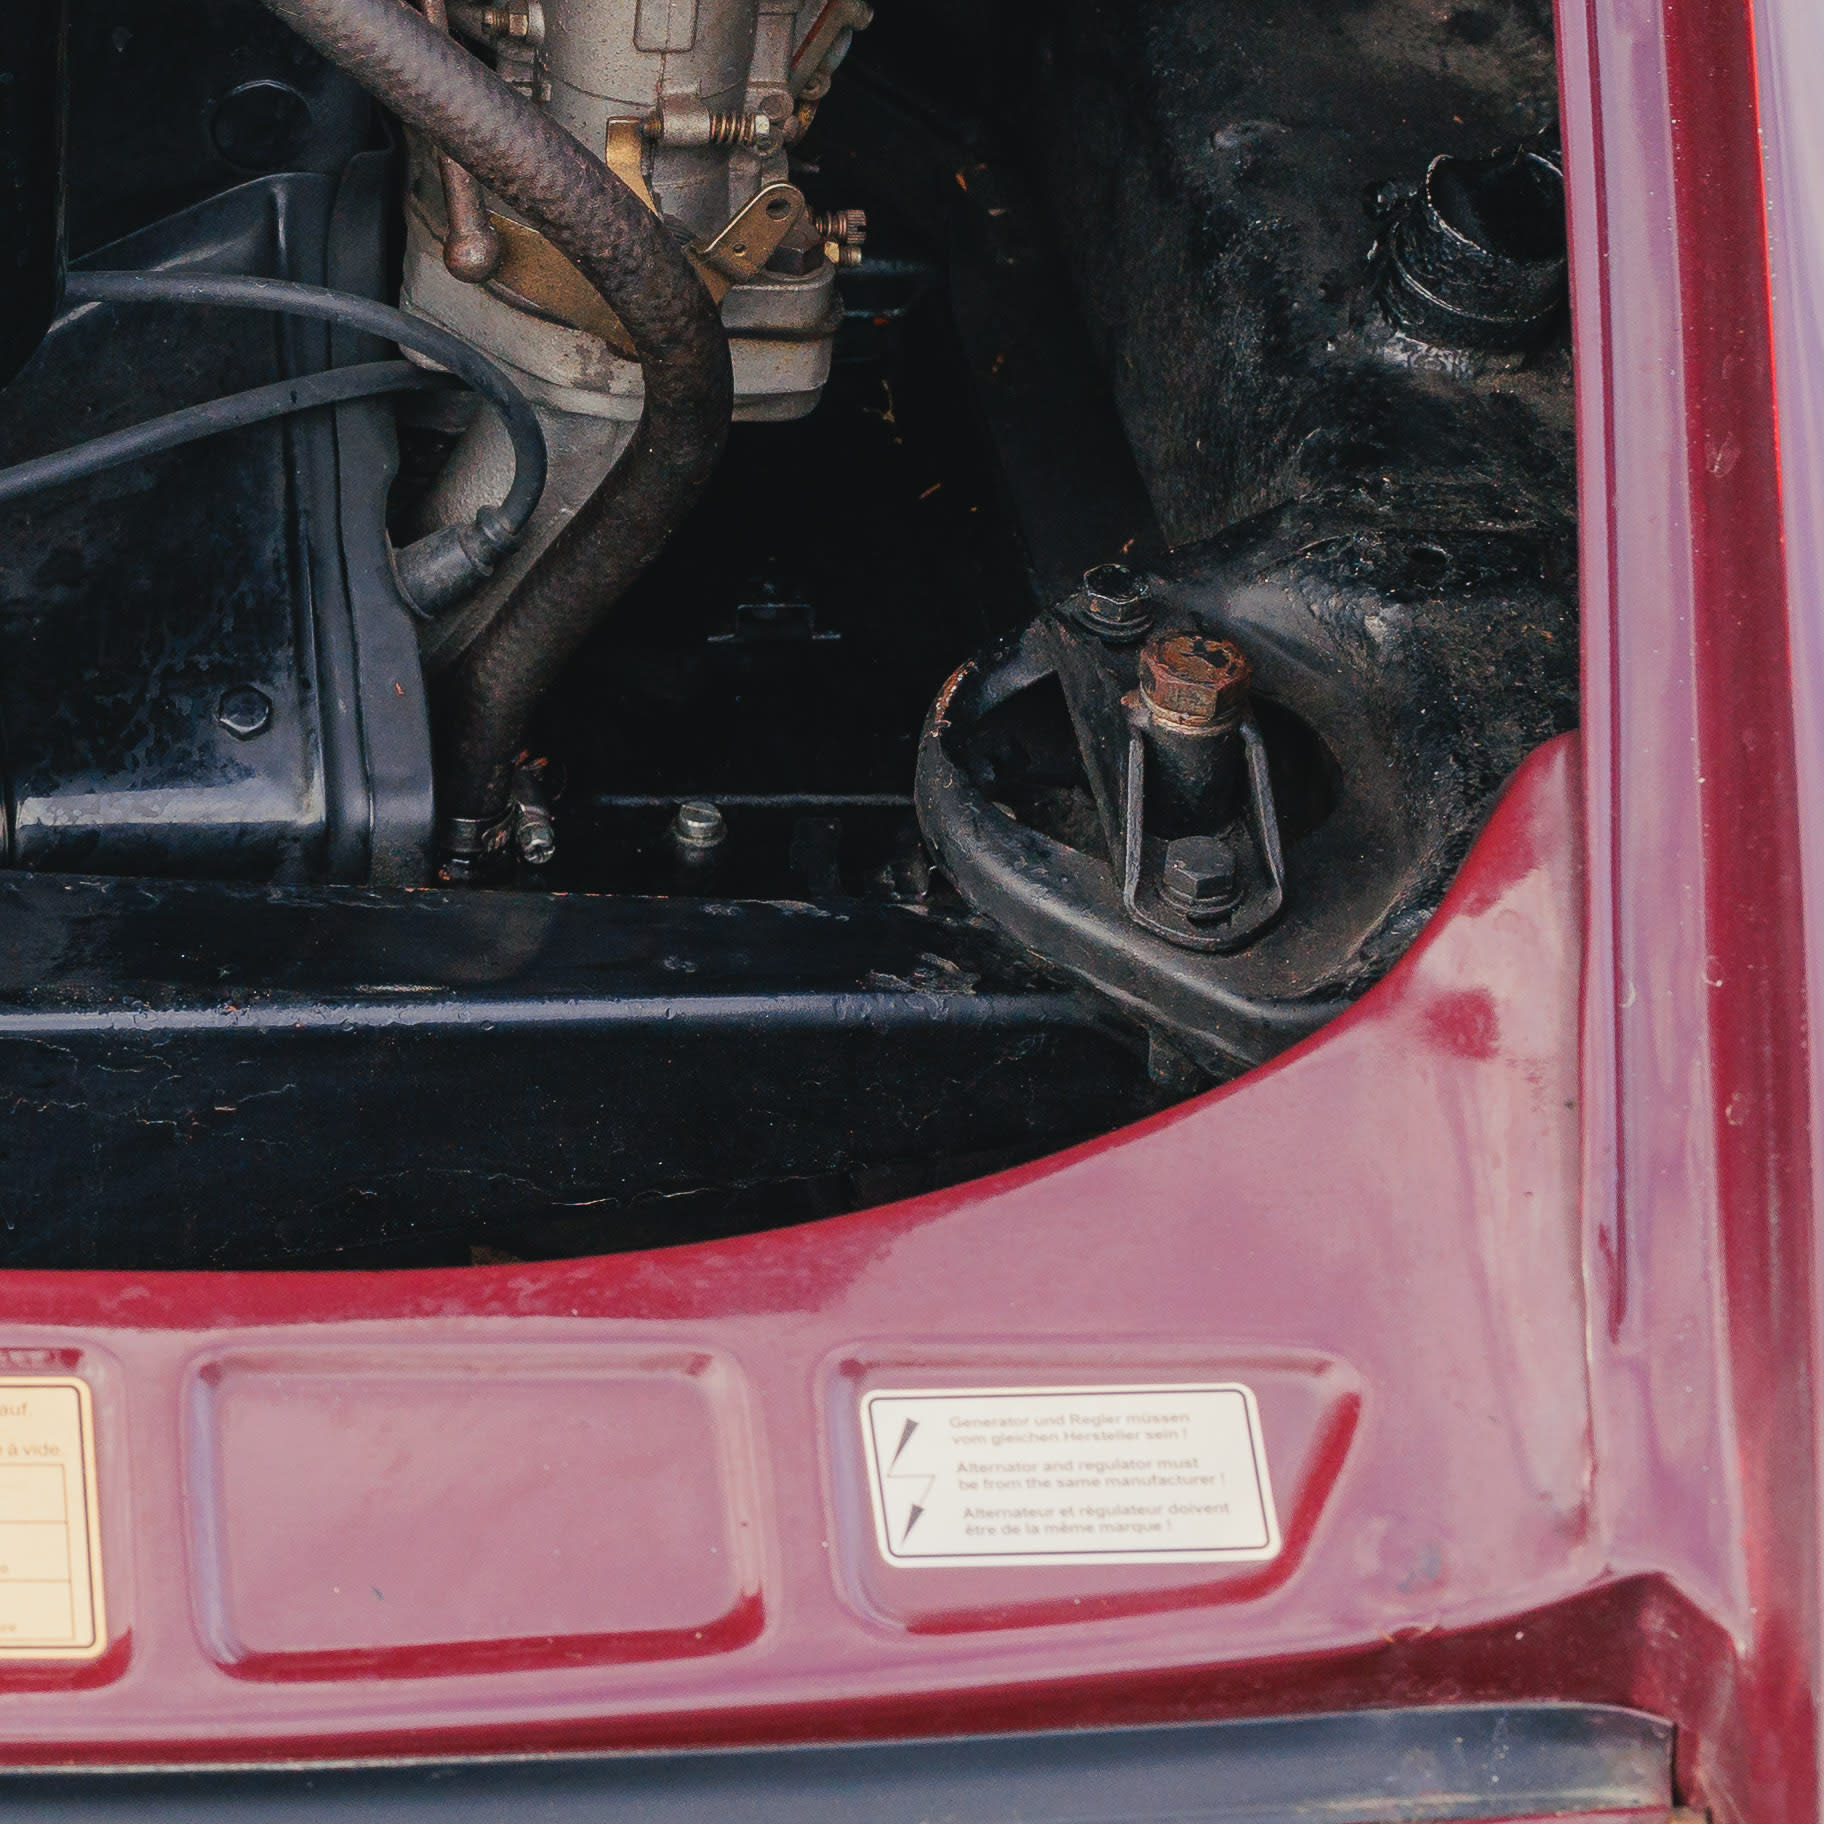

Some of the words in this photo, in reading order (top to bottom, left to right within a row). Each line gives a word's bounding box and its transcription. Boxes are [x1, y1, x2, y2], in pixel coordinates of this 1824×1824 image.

[949, 1415, 1030, 1428] Generator
[1034, 1414, 1065, 1426] und
[956, 1460, 1038, 1474] Alternator
[1042, 1459, 1073, 1473] and
[1078, 1458, 1152, 1474] regulator
[1156, 1457, 1200, 1470] must
[1026, 1477, 1052, 1489] the
[963, 1507, 1055, 1520] Alternateur
[1167, 1502, 1230, 1514] doivent
